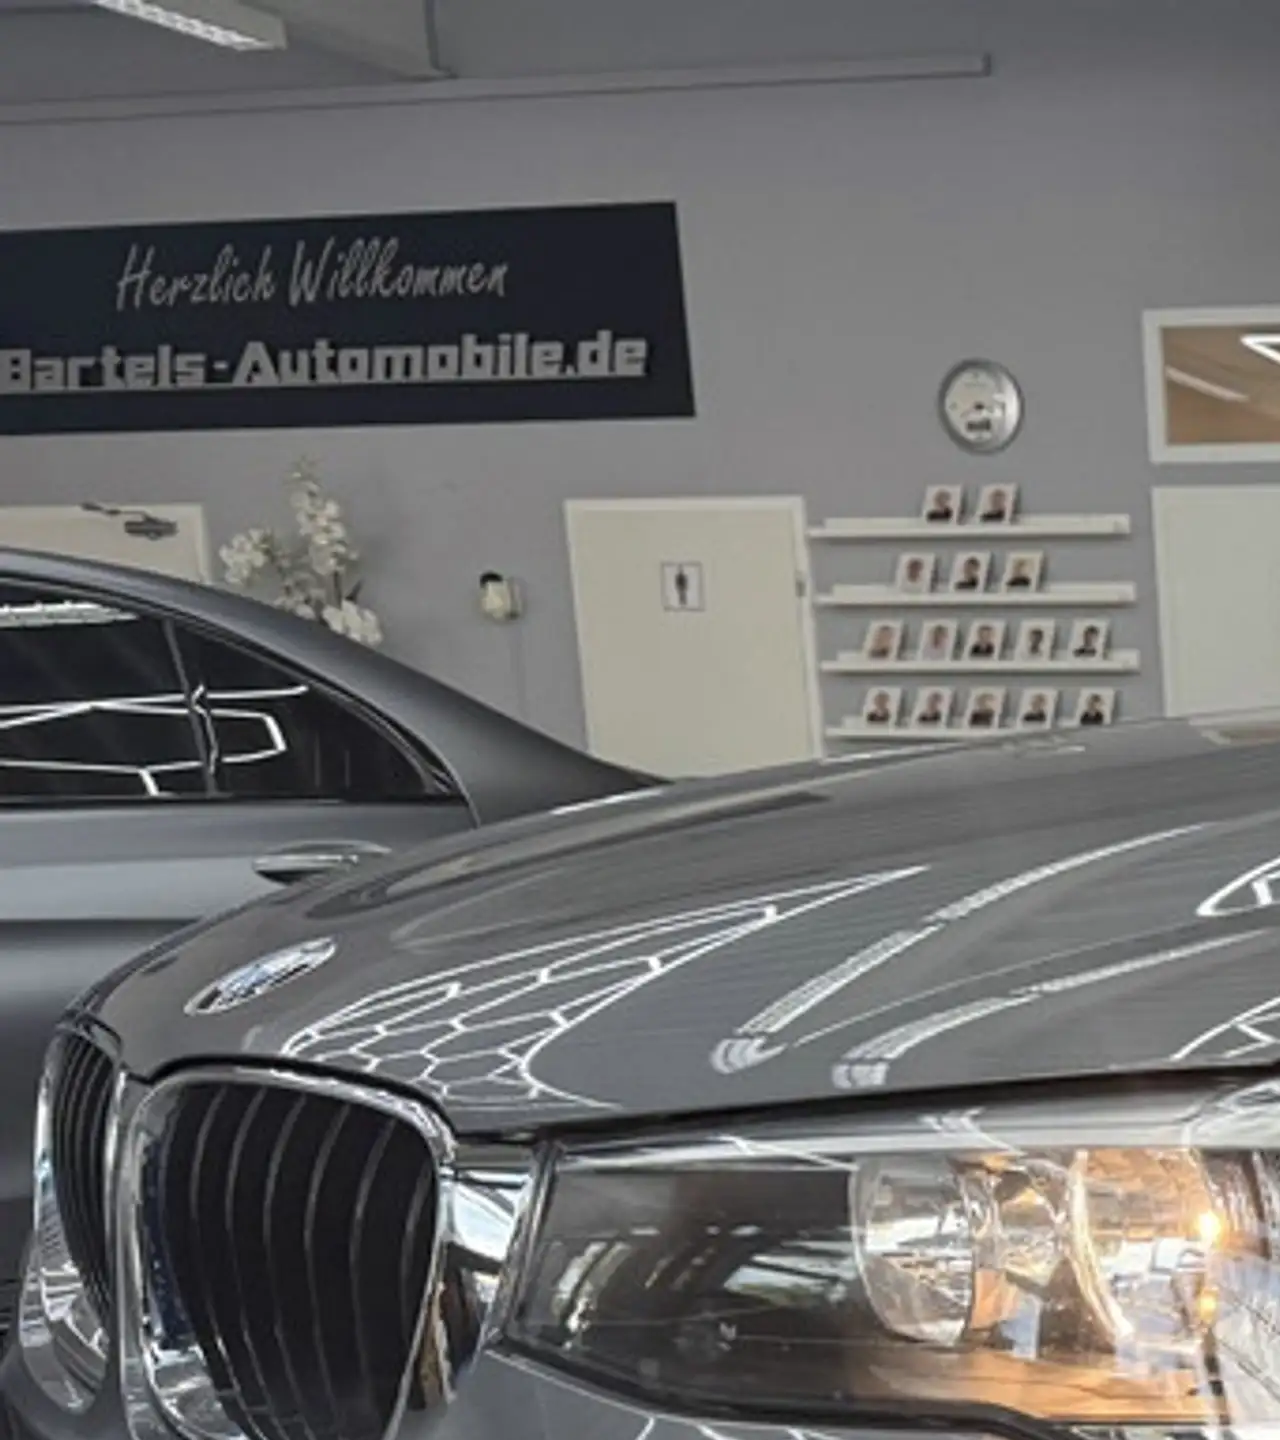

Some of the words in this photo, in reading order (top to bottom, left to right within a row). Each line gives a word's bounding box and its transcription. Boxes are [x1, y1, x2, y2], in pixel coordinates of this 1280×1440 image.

[115, 242, 275, 310] Herzlich
[288, 235, 509, 308] Willkommen
[0, 329, 648, 393] Bartels-Automobile.de
